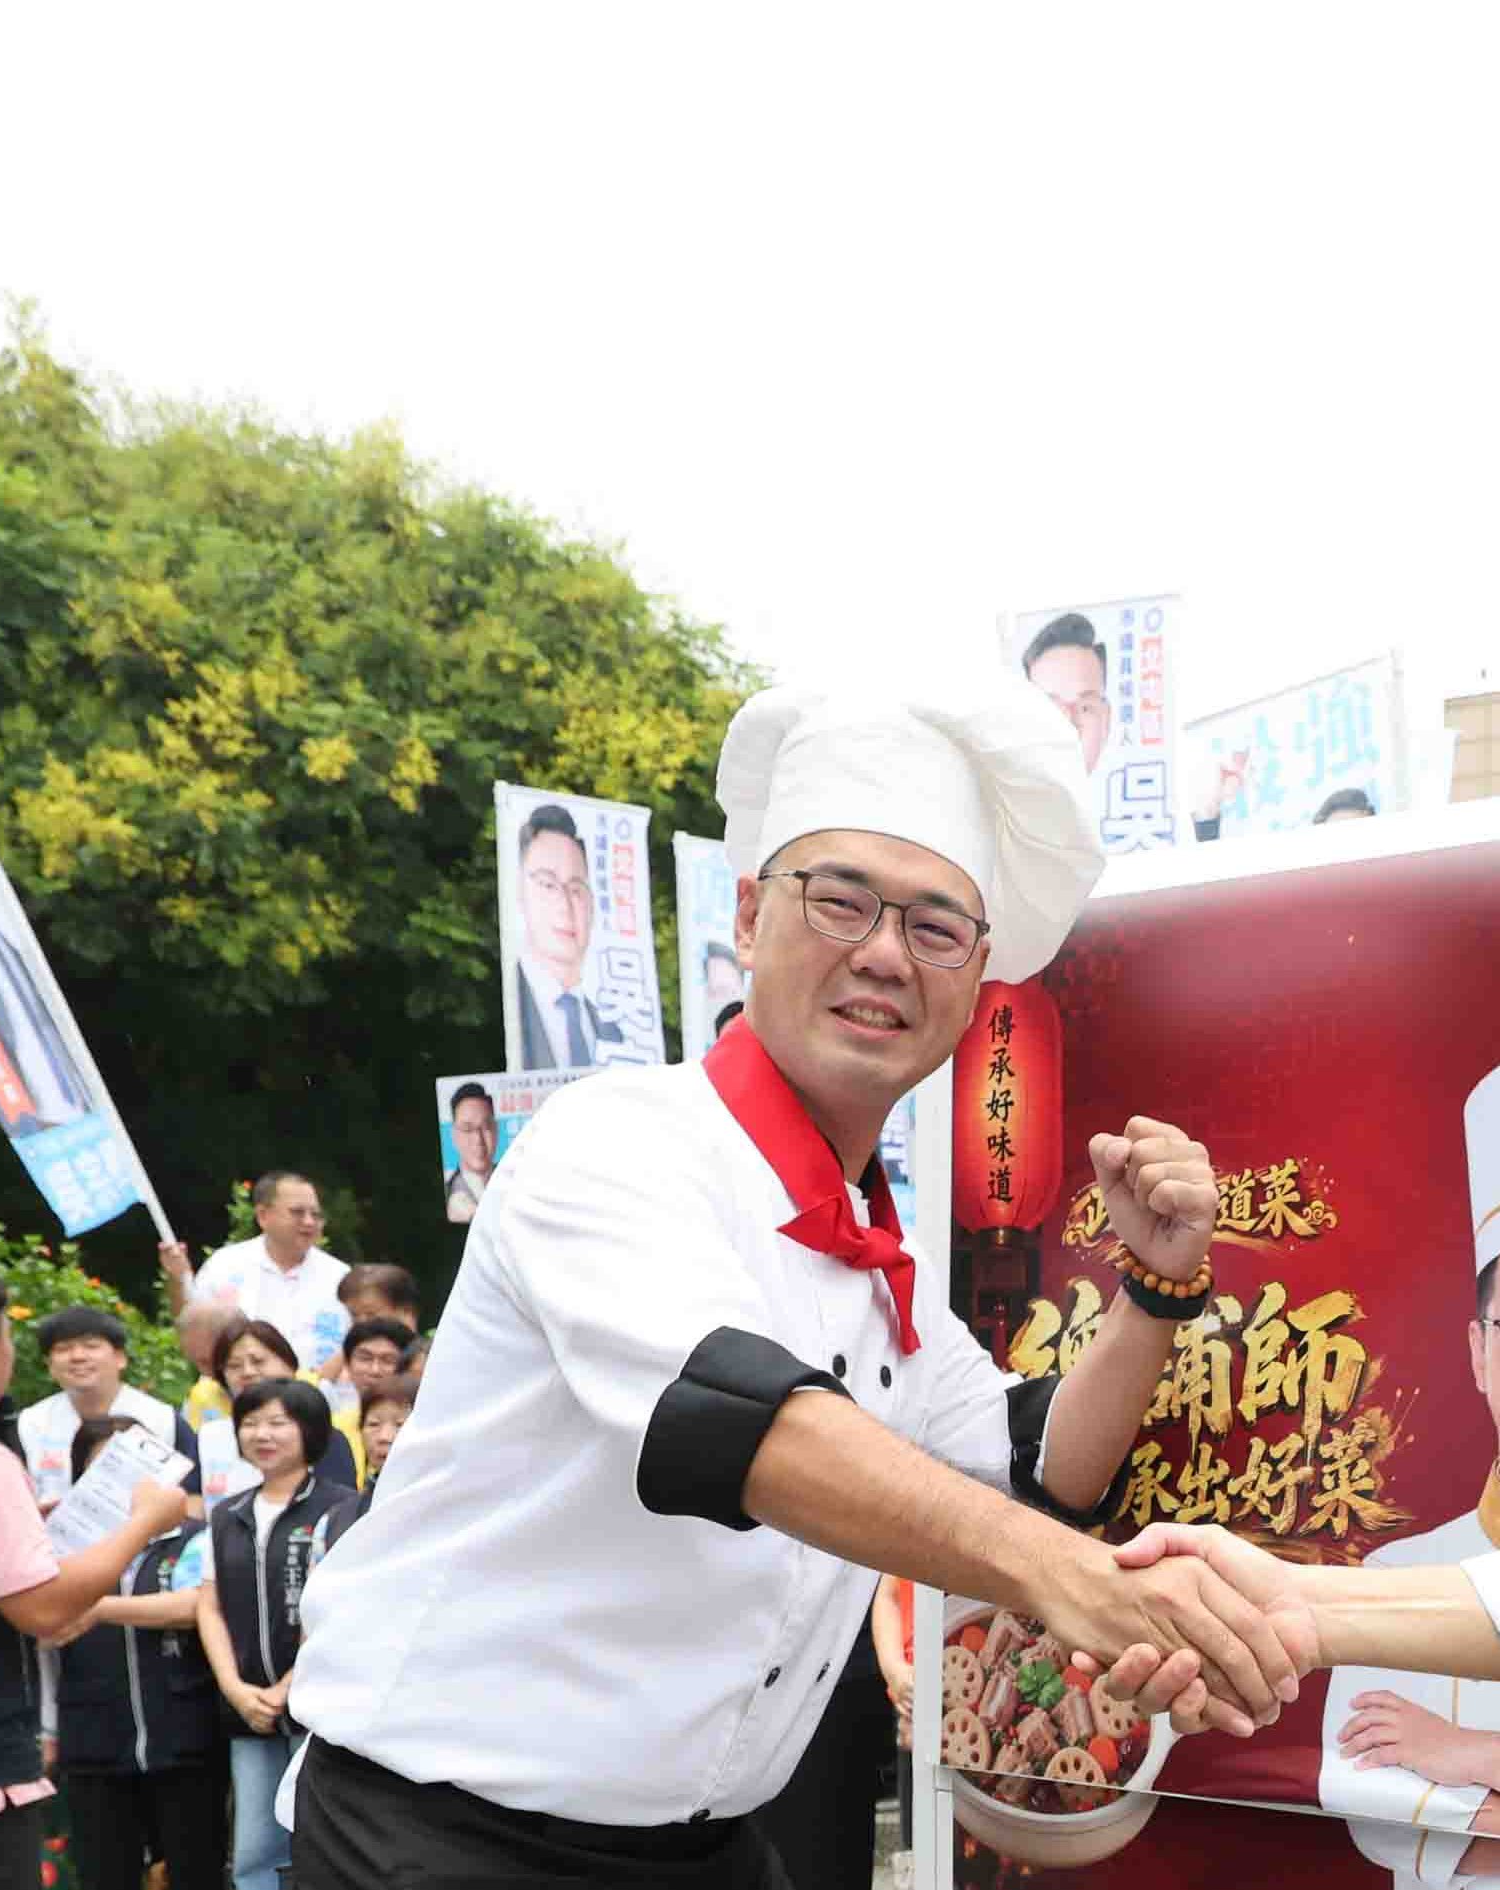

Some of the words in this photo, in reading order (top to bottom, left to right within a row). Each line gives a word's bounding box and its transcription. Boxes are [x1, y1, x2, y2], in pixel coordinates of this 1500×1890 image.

[985, 1004, 1017, 1205] 傳承好味道
[1112, 1422, 1412, 1540] 承出好菜
